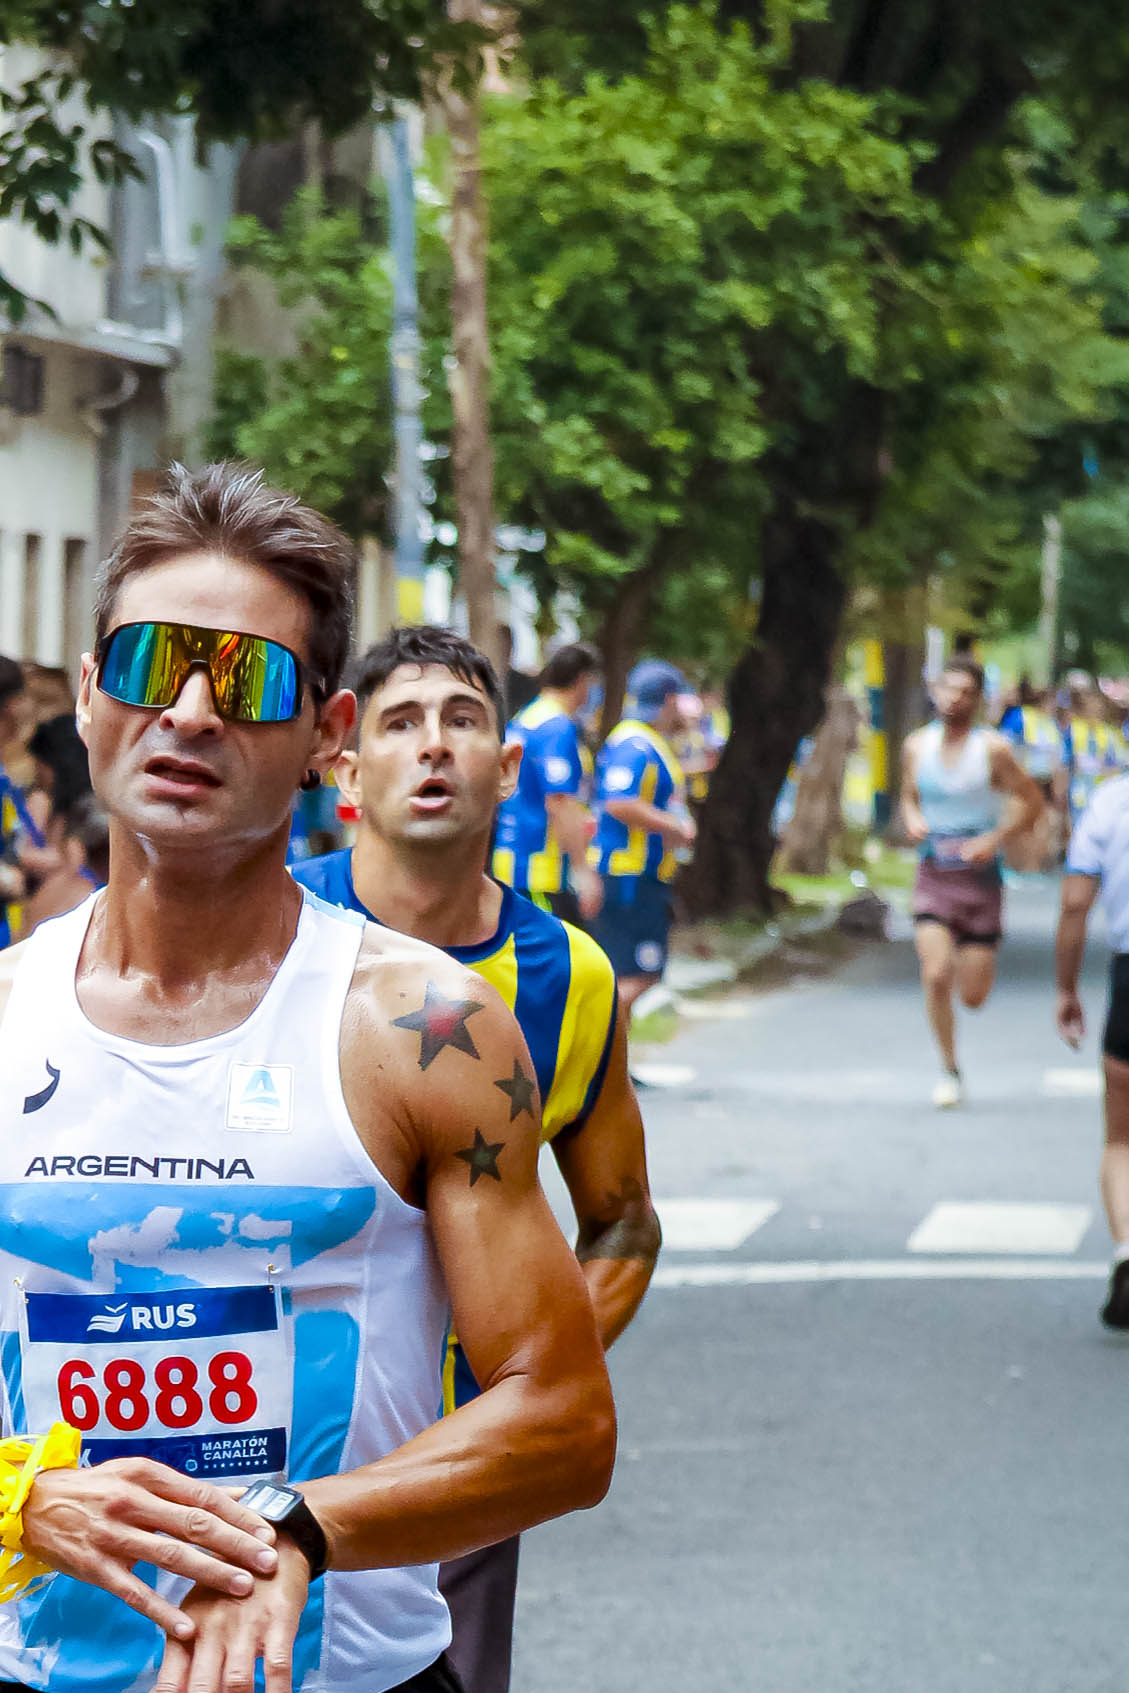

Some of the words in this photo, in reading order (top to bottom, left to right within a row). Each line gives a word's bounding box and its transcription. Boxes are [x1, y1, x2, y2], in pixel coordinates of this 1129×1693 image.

[24, 1155, 255, 1180] ARGENTINA
[132, 1303, 198, 1331] RUS
[57, 1351, 258, 1432] 6888
[201, 1435, 268, 1451] MARATÓN
[203, 1447, 268, 1461] CANALLA
